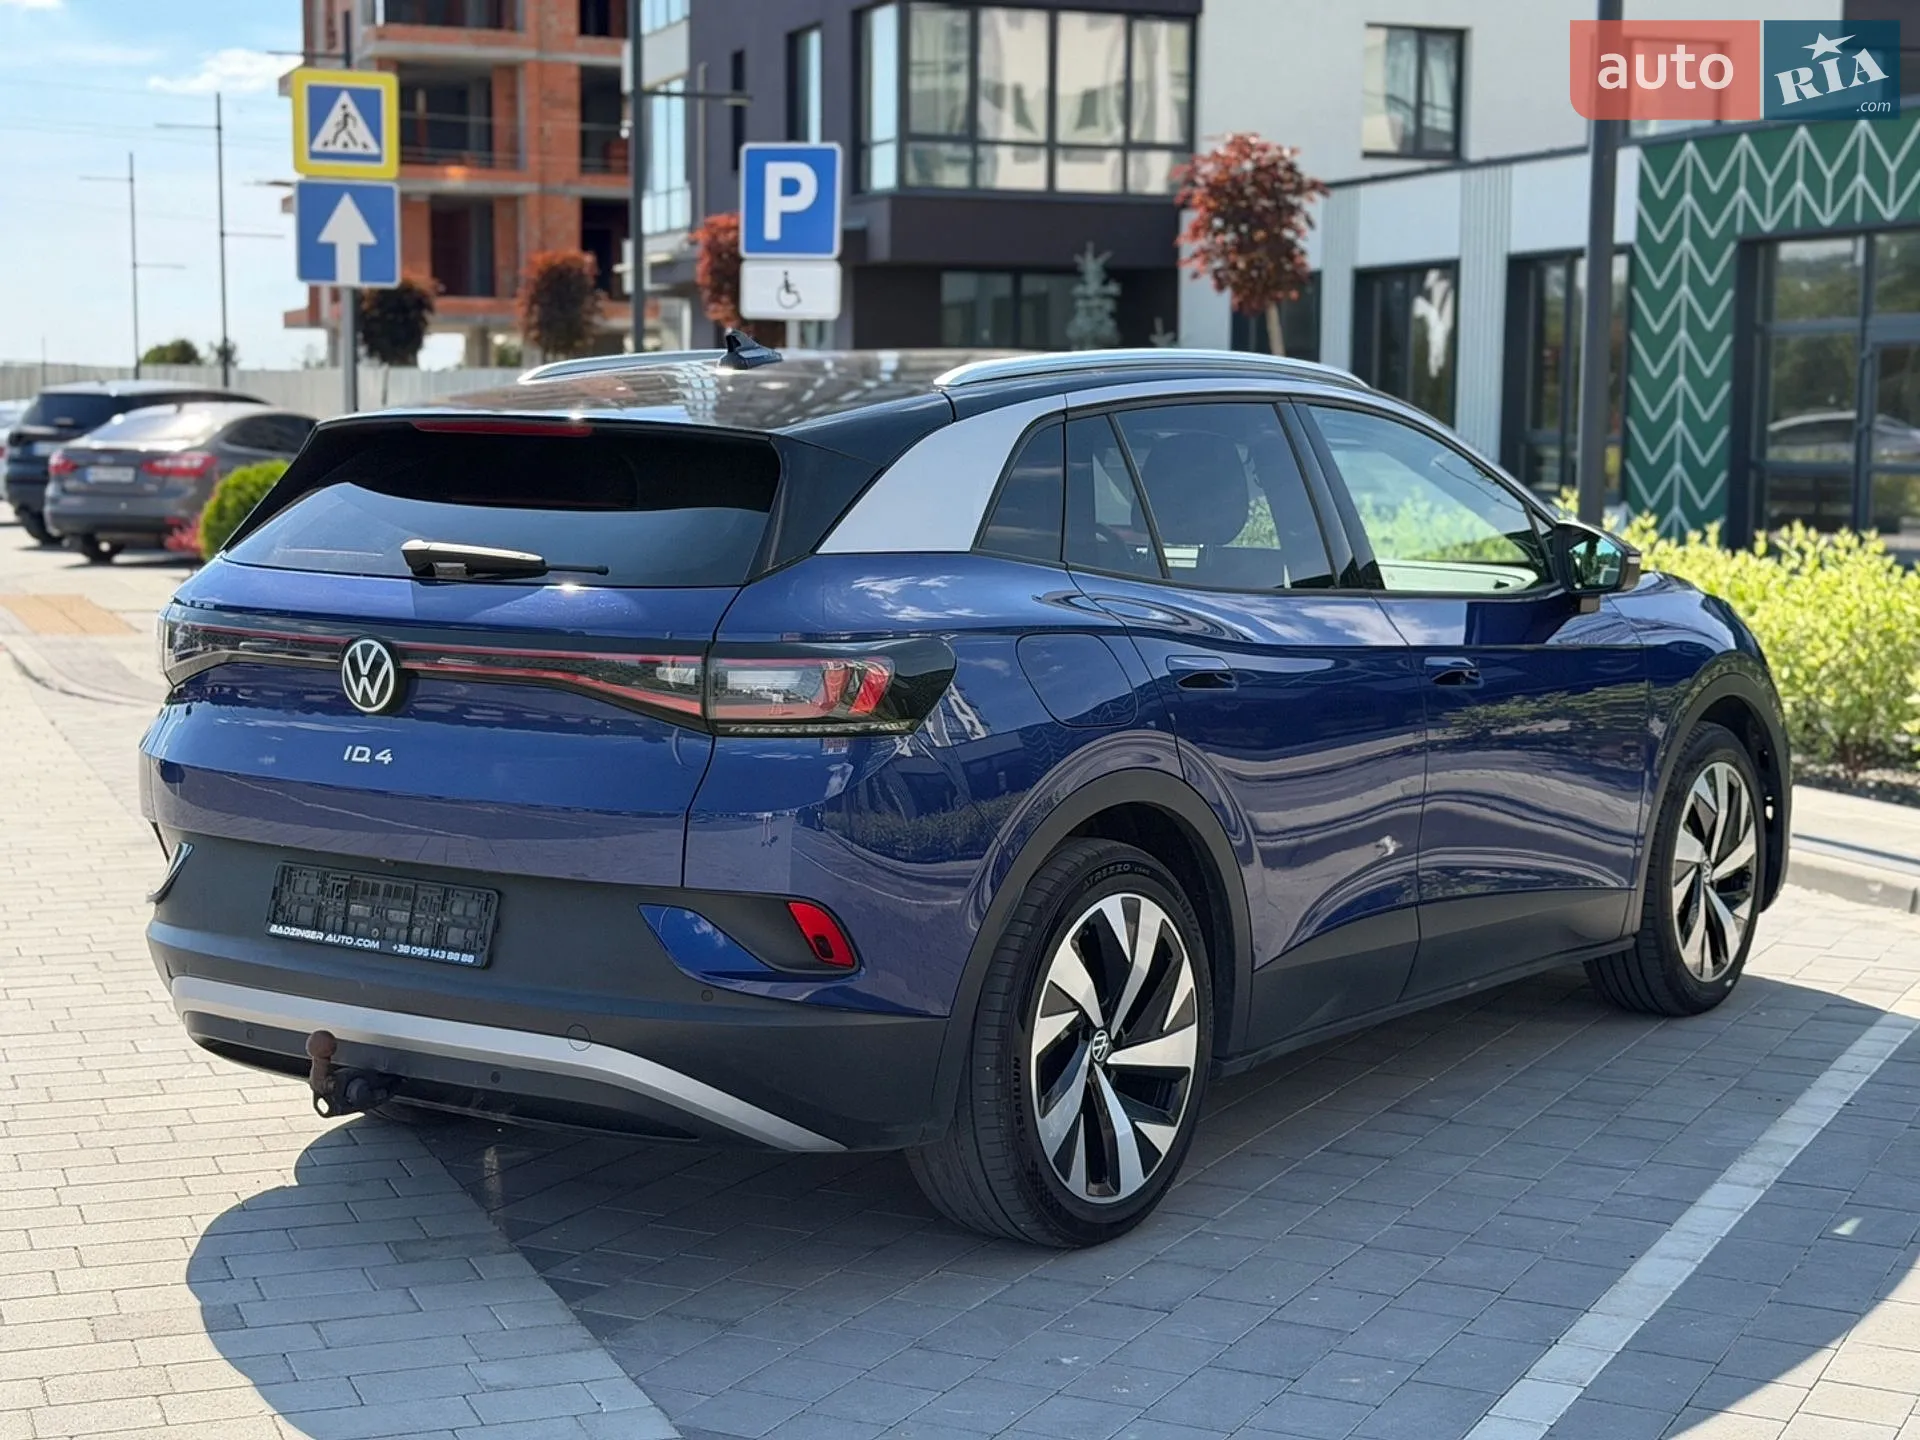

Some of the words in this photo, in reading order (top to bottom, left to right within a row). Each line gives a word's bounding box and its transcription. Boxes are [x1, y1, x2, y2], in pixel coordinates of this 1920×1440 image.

[763, 161, 818, 241] P
[392, 944, 410, 953] +38
[411, 946, 430, 957] 095
